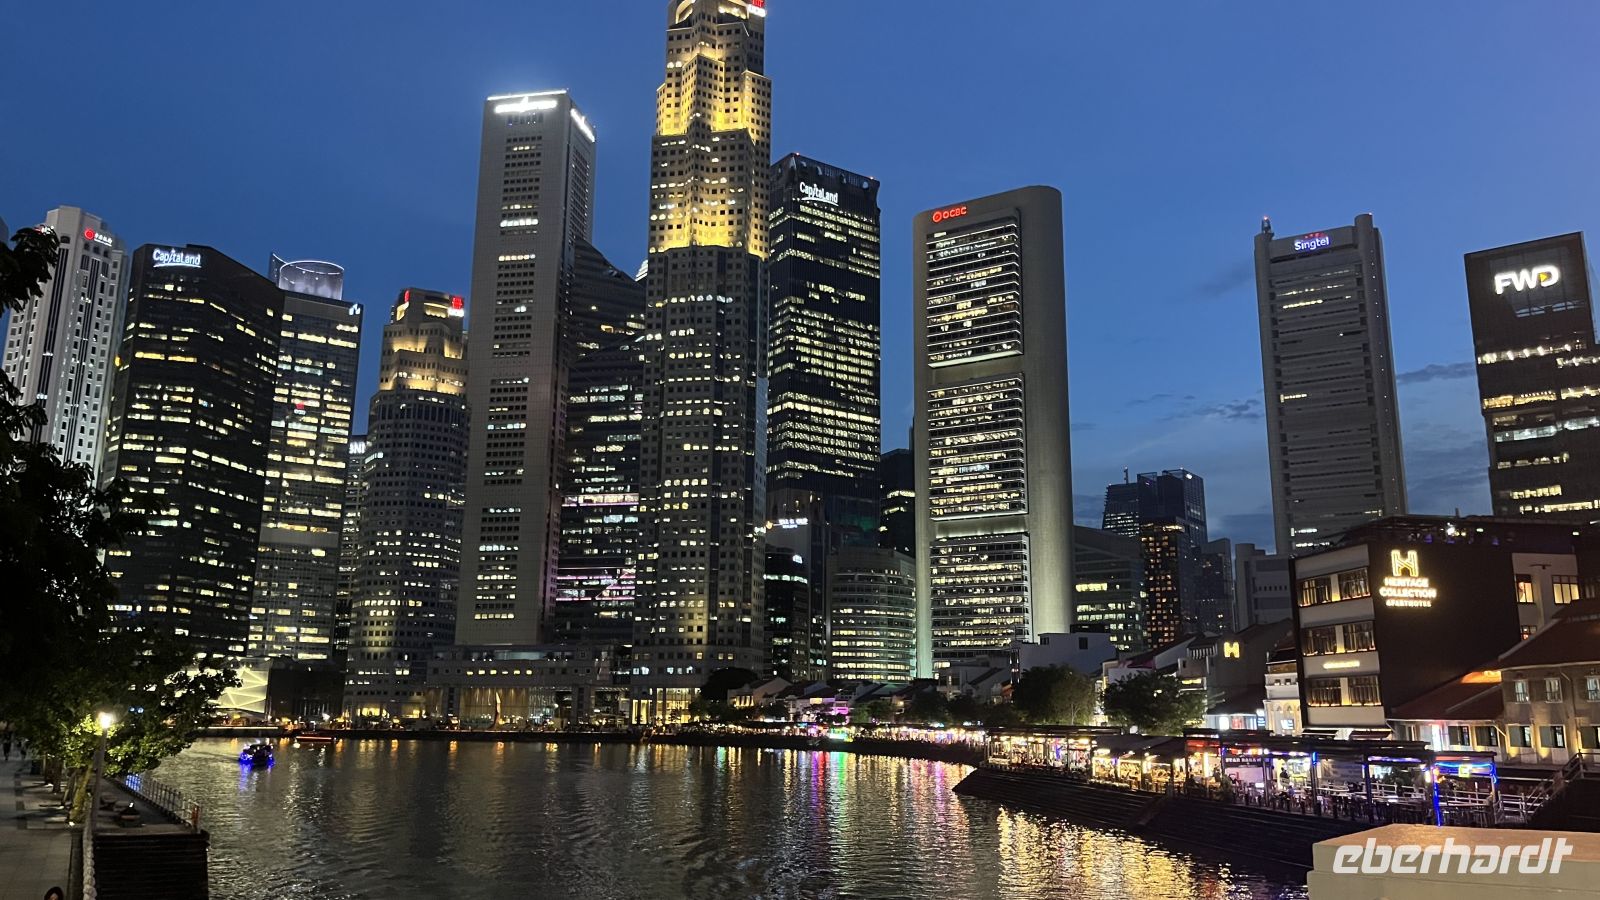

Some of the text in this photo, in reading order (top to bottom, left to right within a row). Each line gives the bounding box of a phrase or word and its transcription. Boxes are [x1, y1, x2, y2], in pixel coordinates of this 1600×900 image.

[800, 181, 839, 204] CapitaLand
[942, 206, 967, 219] OCBC
[1294, 236, 1329, 251] Singtel
[152, 248, 201, 266] CapitaLand
[1494, 265, 1559, 295] FWD
[1379, 587, 1437, 598] COLLECTION
